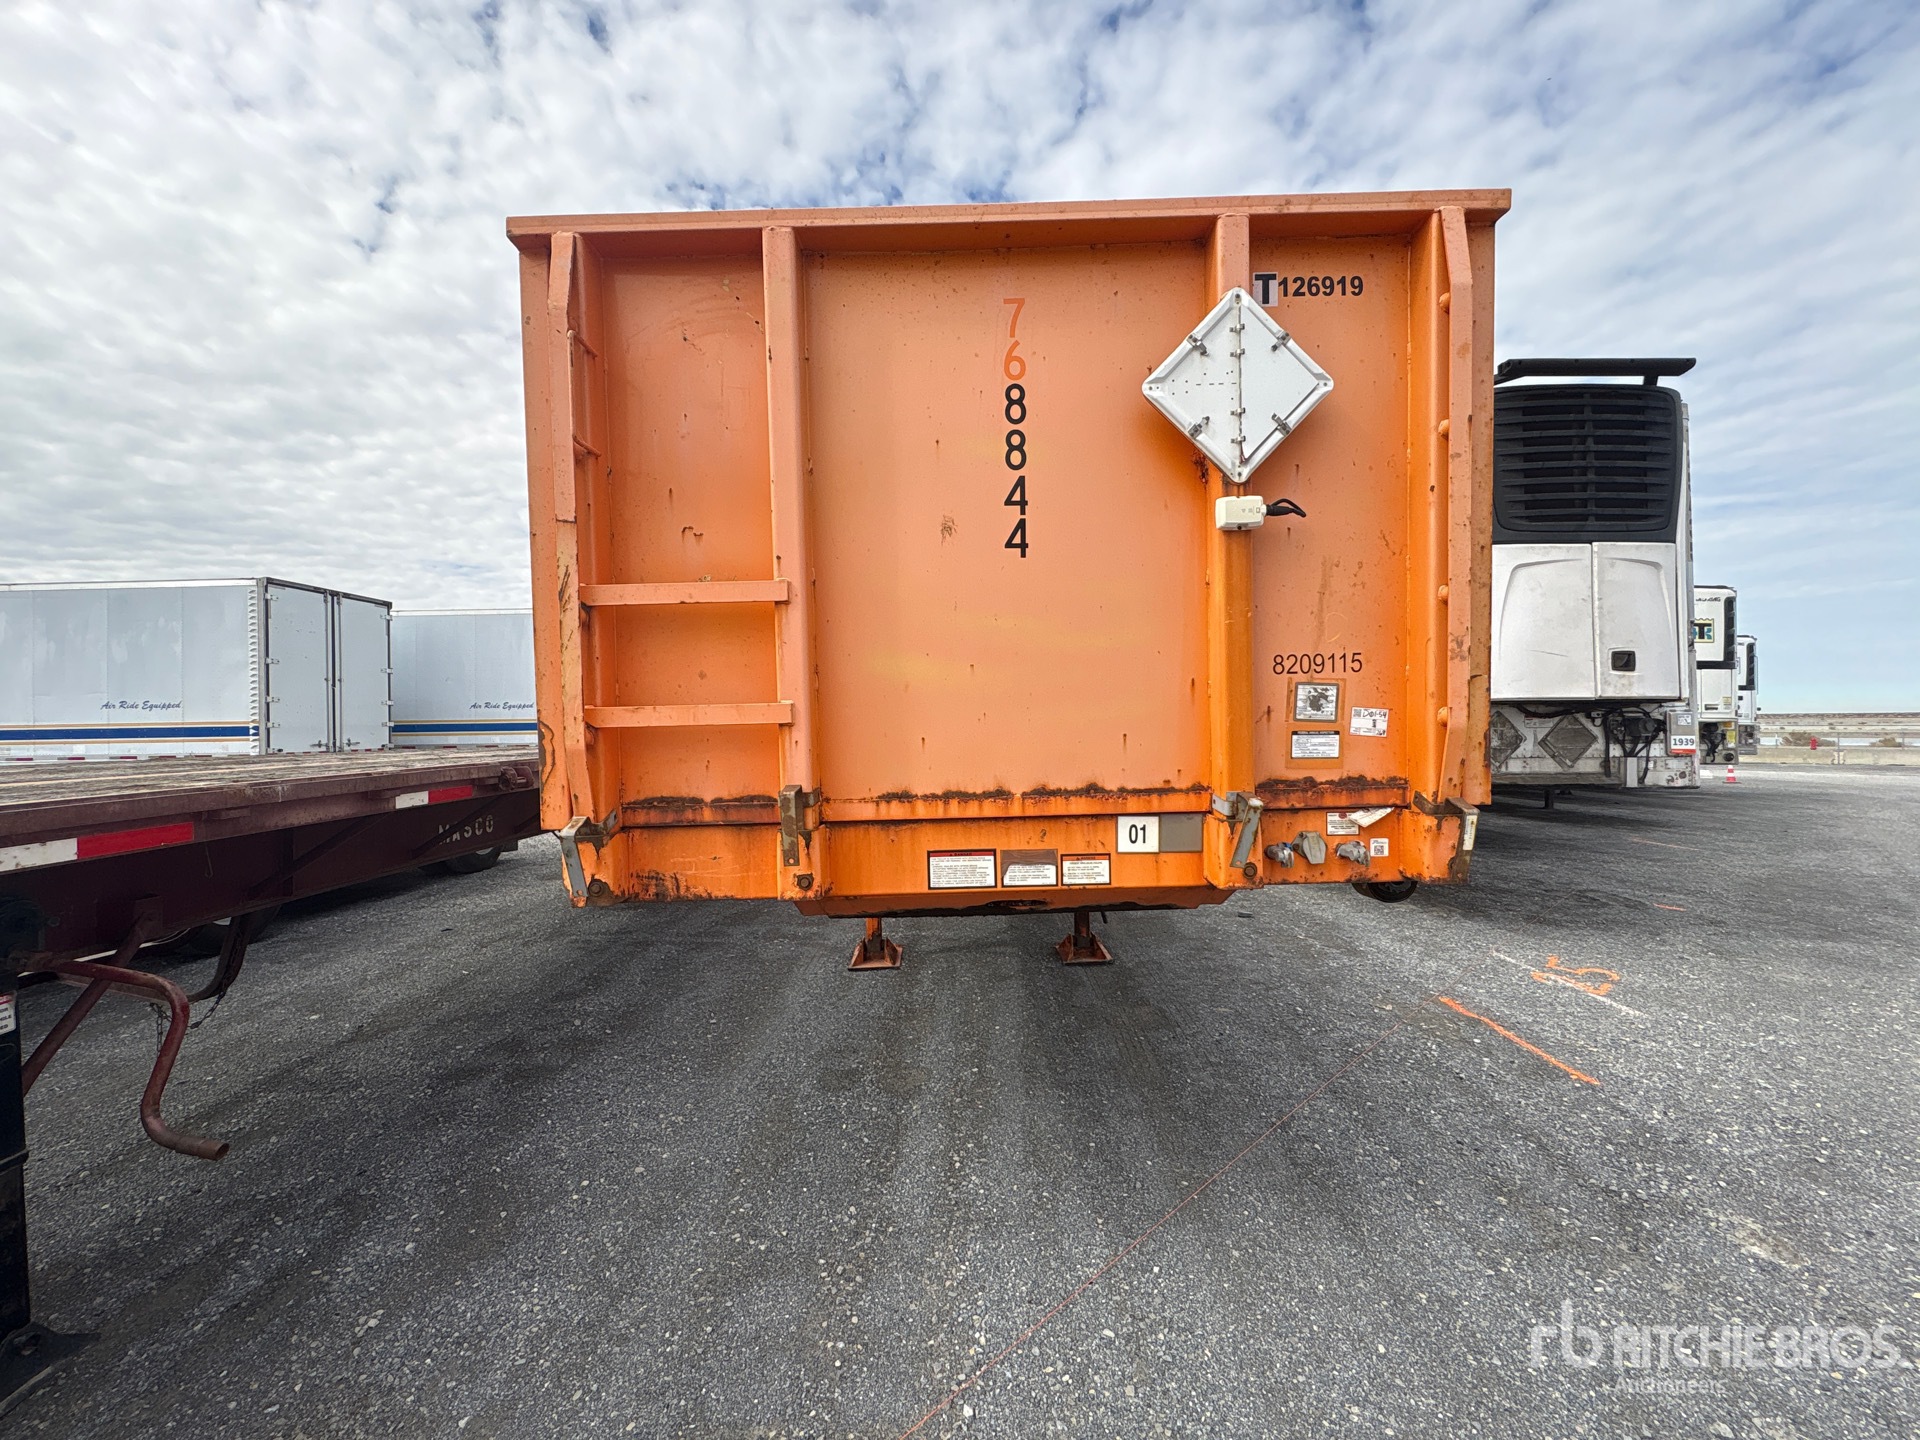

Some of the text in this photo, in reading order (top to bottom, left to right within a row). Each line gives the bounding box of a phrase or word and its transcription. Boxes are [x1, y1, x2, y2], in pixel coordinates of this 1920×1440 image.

[1003, 298, 1028, 558] 768844
[1273, 652, 1363, 675] 8209115
[100, 700, 182, 712] Air Ride Equipped
[502, 701, 534, 710] Equipped
[1672, 738, 1695, 746] 1939
[1128, 824, 1147, 844] 01
